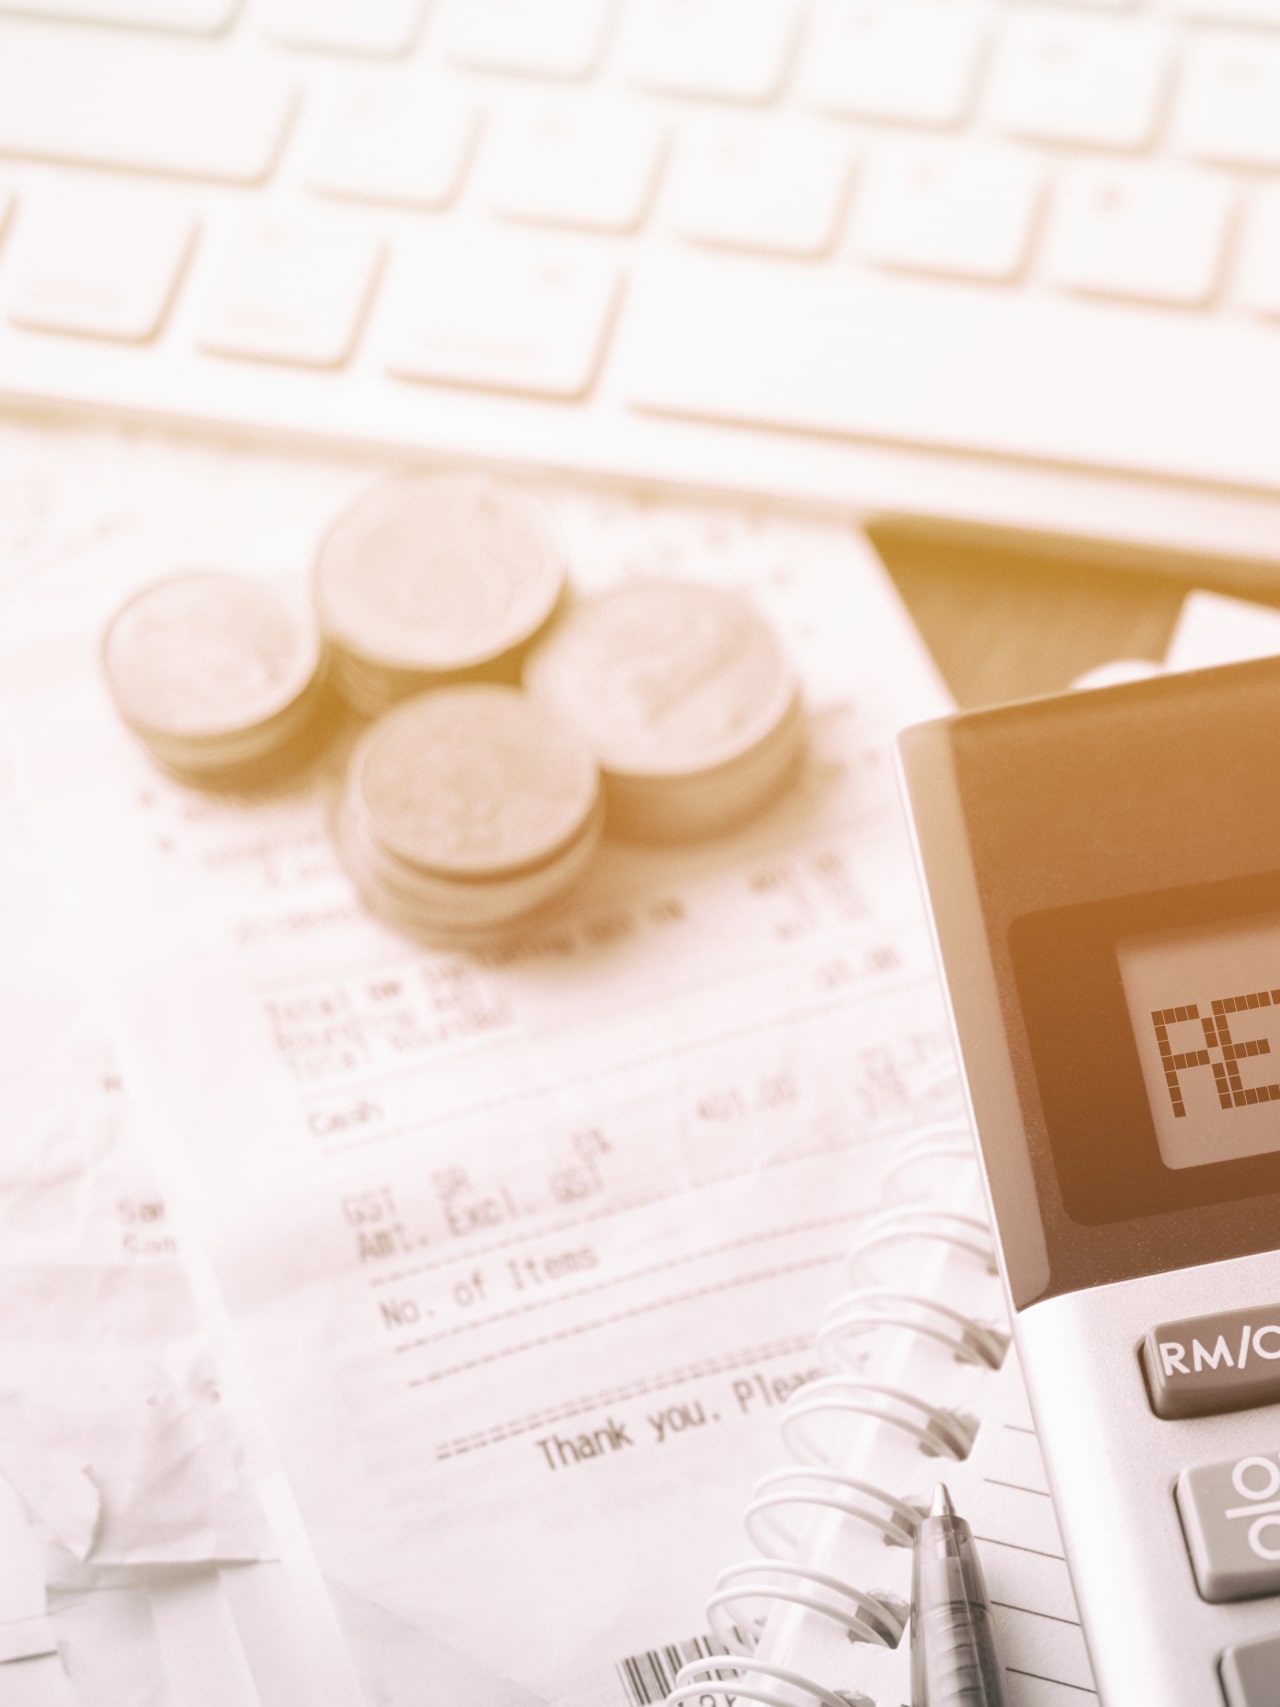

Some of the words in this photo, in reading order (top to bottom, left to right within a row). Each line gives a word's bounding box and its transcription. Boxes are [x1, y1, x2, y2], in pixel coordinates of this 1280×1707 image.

[376, 1295, 436, 1331] No.
[451, 1270, 488, 1310] of
[506, 1243, 600, 1292] Items
[534, 1415, 637, 1472] Thank
[645, 1397, 722, 1445] you.
